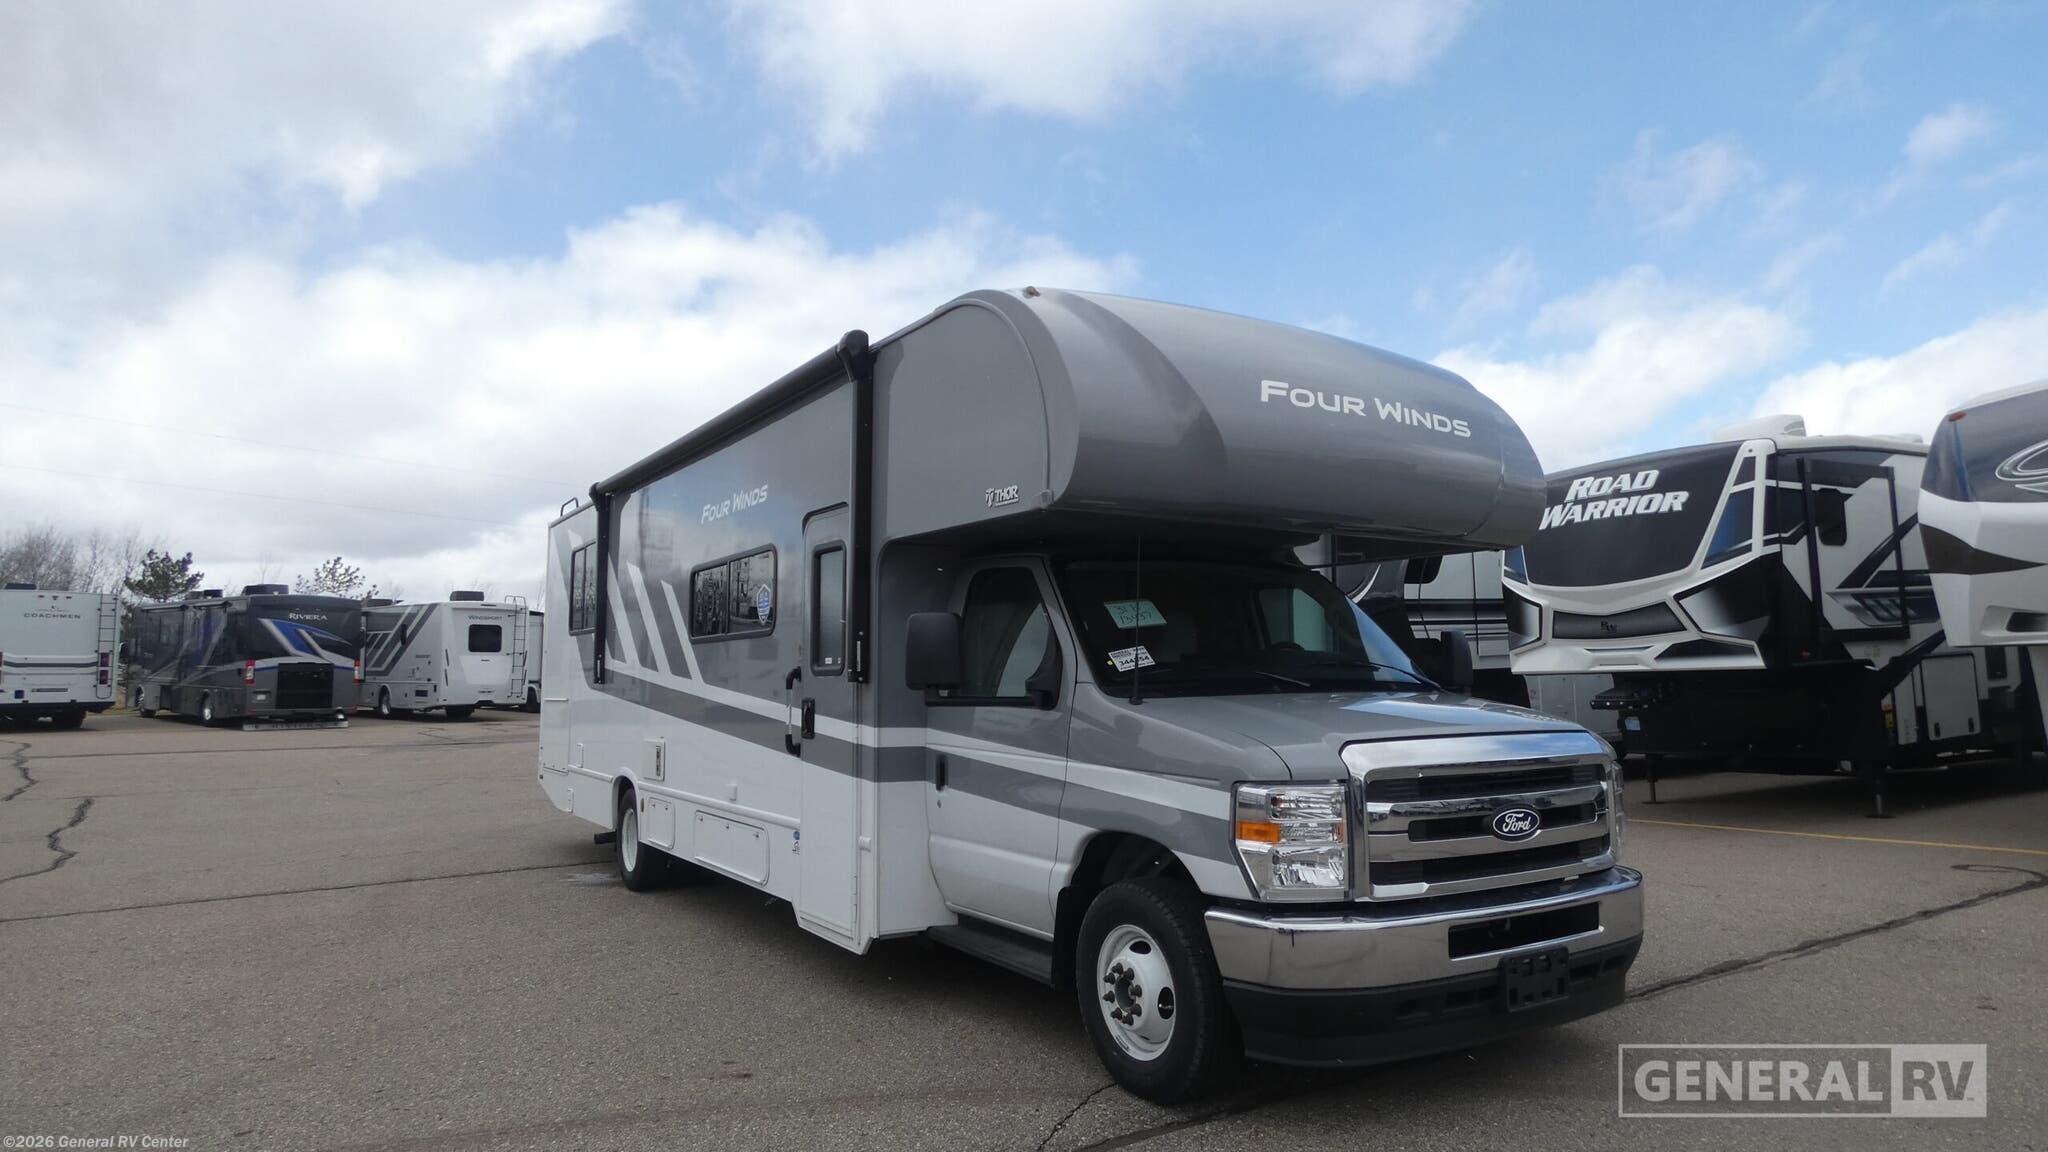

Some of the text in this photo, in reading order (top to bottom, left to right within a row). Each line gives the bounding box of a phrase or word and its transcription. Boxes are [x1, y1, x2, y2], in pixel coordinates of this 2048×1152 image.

[1261, 379, 1471, 438] FOUR WINDS
[995, 485, 1019, 502] THOR
[1564, 469, 1660, 503] ROAD
[1538, 490, 1689, 531] WARRIOR
[289, 612, 328, 620] RIVIERA
[1502, 813, 1531, 832] Ford
